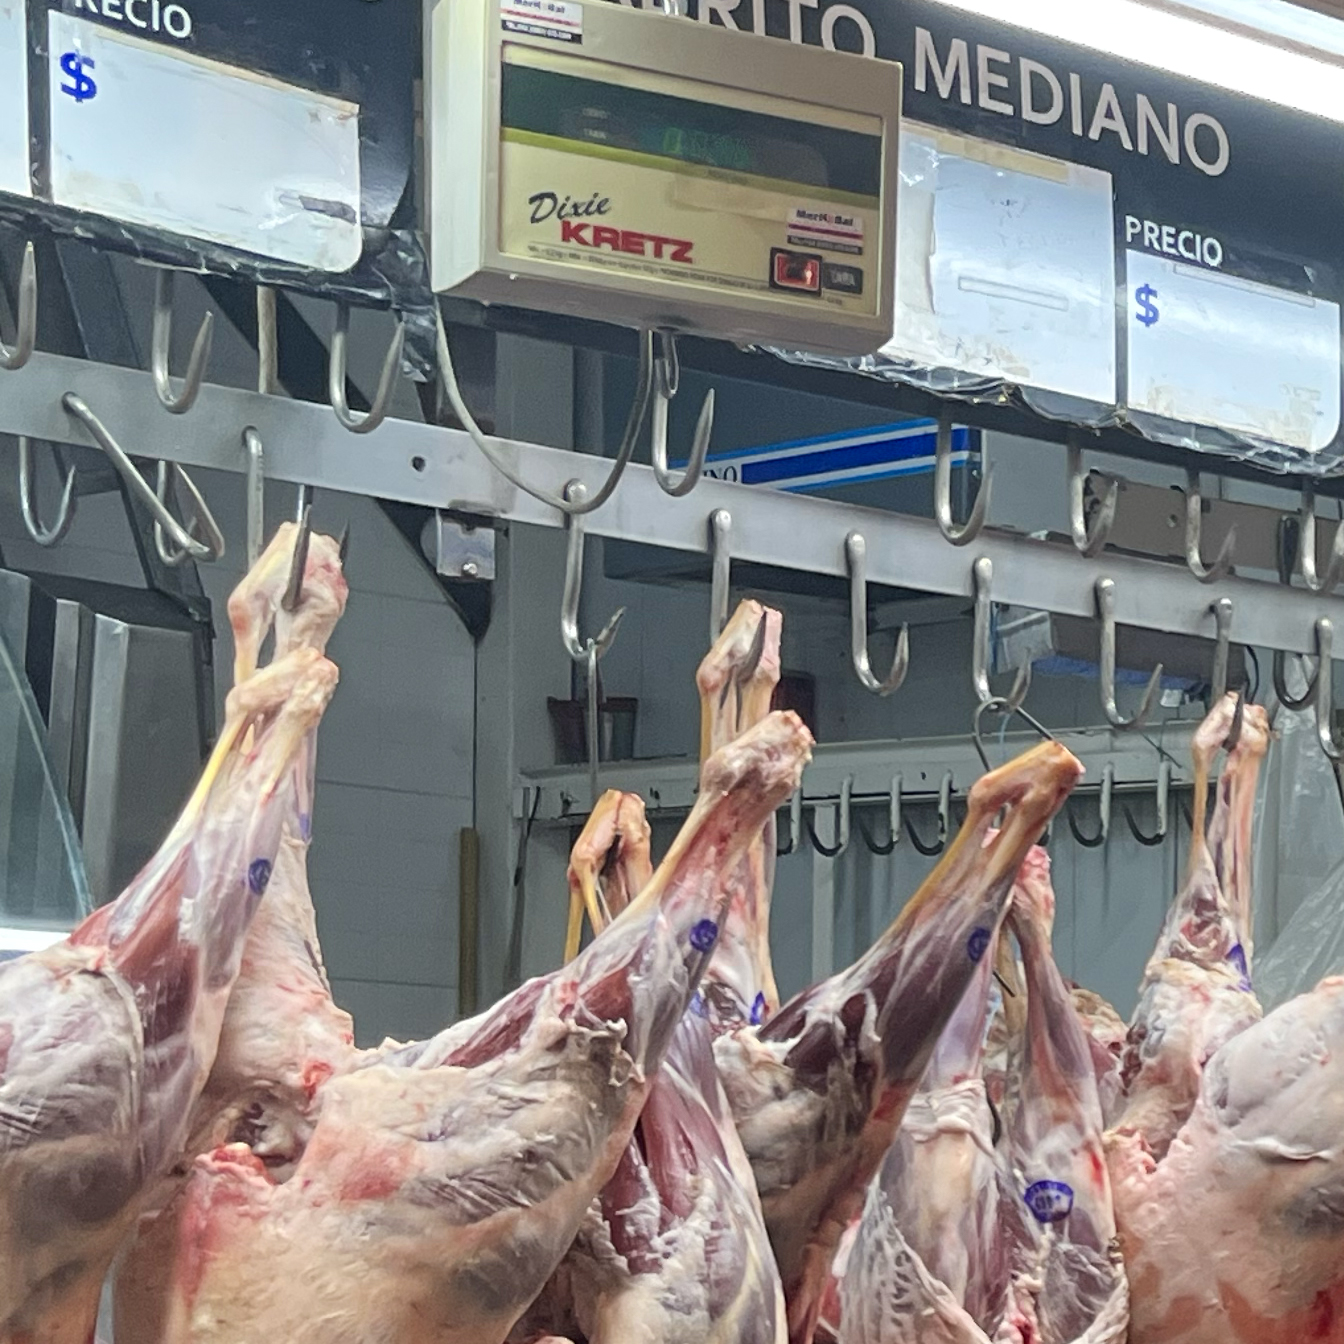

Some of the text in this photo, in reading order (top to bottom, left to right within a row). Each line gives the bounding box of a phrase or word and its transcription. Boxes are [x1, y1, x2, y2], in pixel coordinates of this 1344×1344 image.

[60, 50, 97, 103] $
[914, 26, 1230, 177] MEDIANO
[528, 192, 611, 224] Dixie
[561, 220, 693, 264] KRETZ
[1125, 214, 1224, 268] PRECIO
[1134, 283, 1160, 327] $
